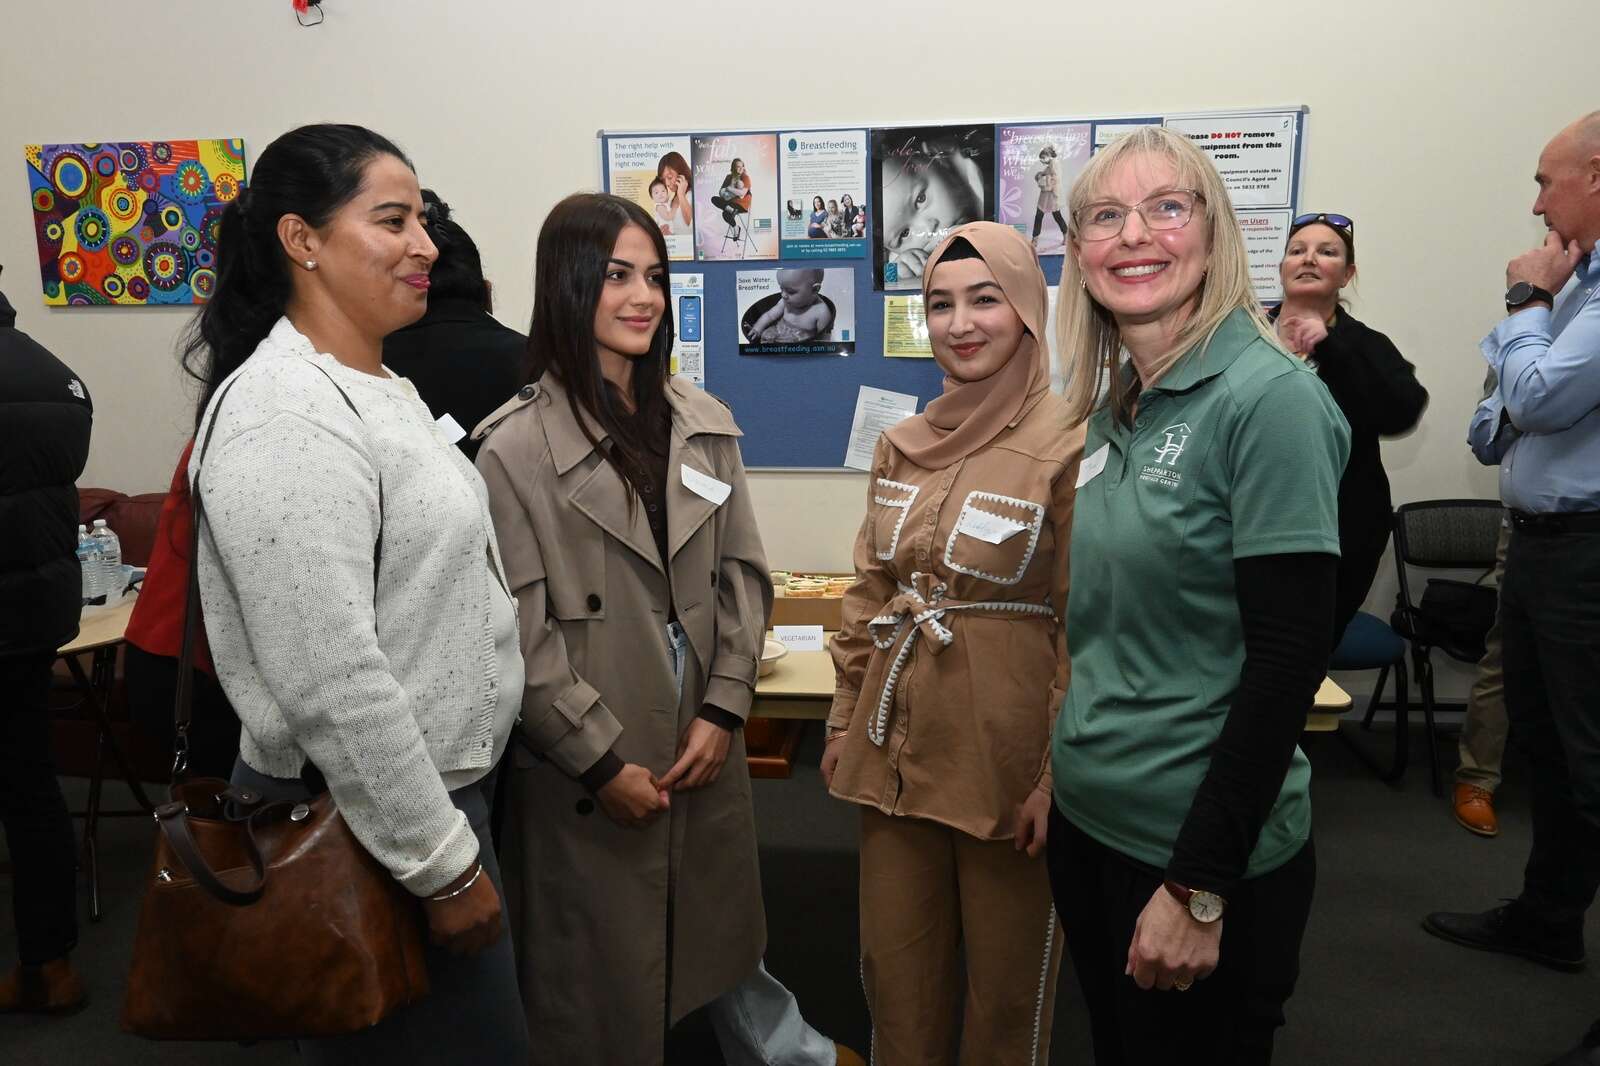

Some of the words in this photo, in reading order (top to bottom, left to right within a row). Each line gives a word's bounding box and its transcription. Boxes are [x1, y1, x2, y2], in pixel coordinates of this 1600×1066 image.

[1225, 131, 1242, 139] NOT
[628, 142, 643, 150] right
[800, 141, 857, 150] Breastfeeding
[1201, 143, 1241, 151] quipment
